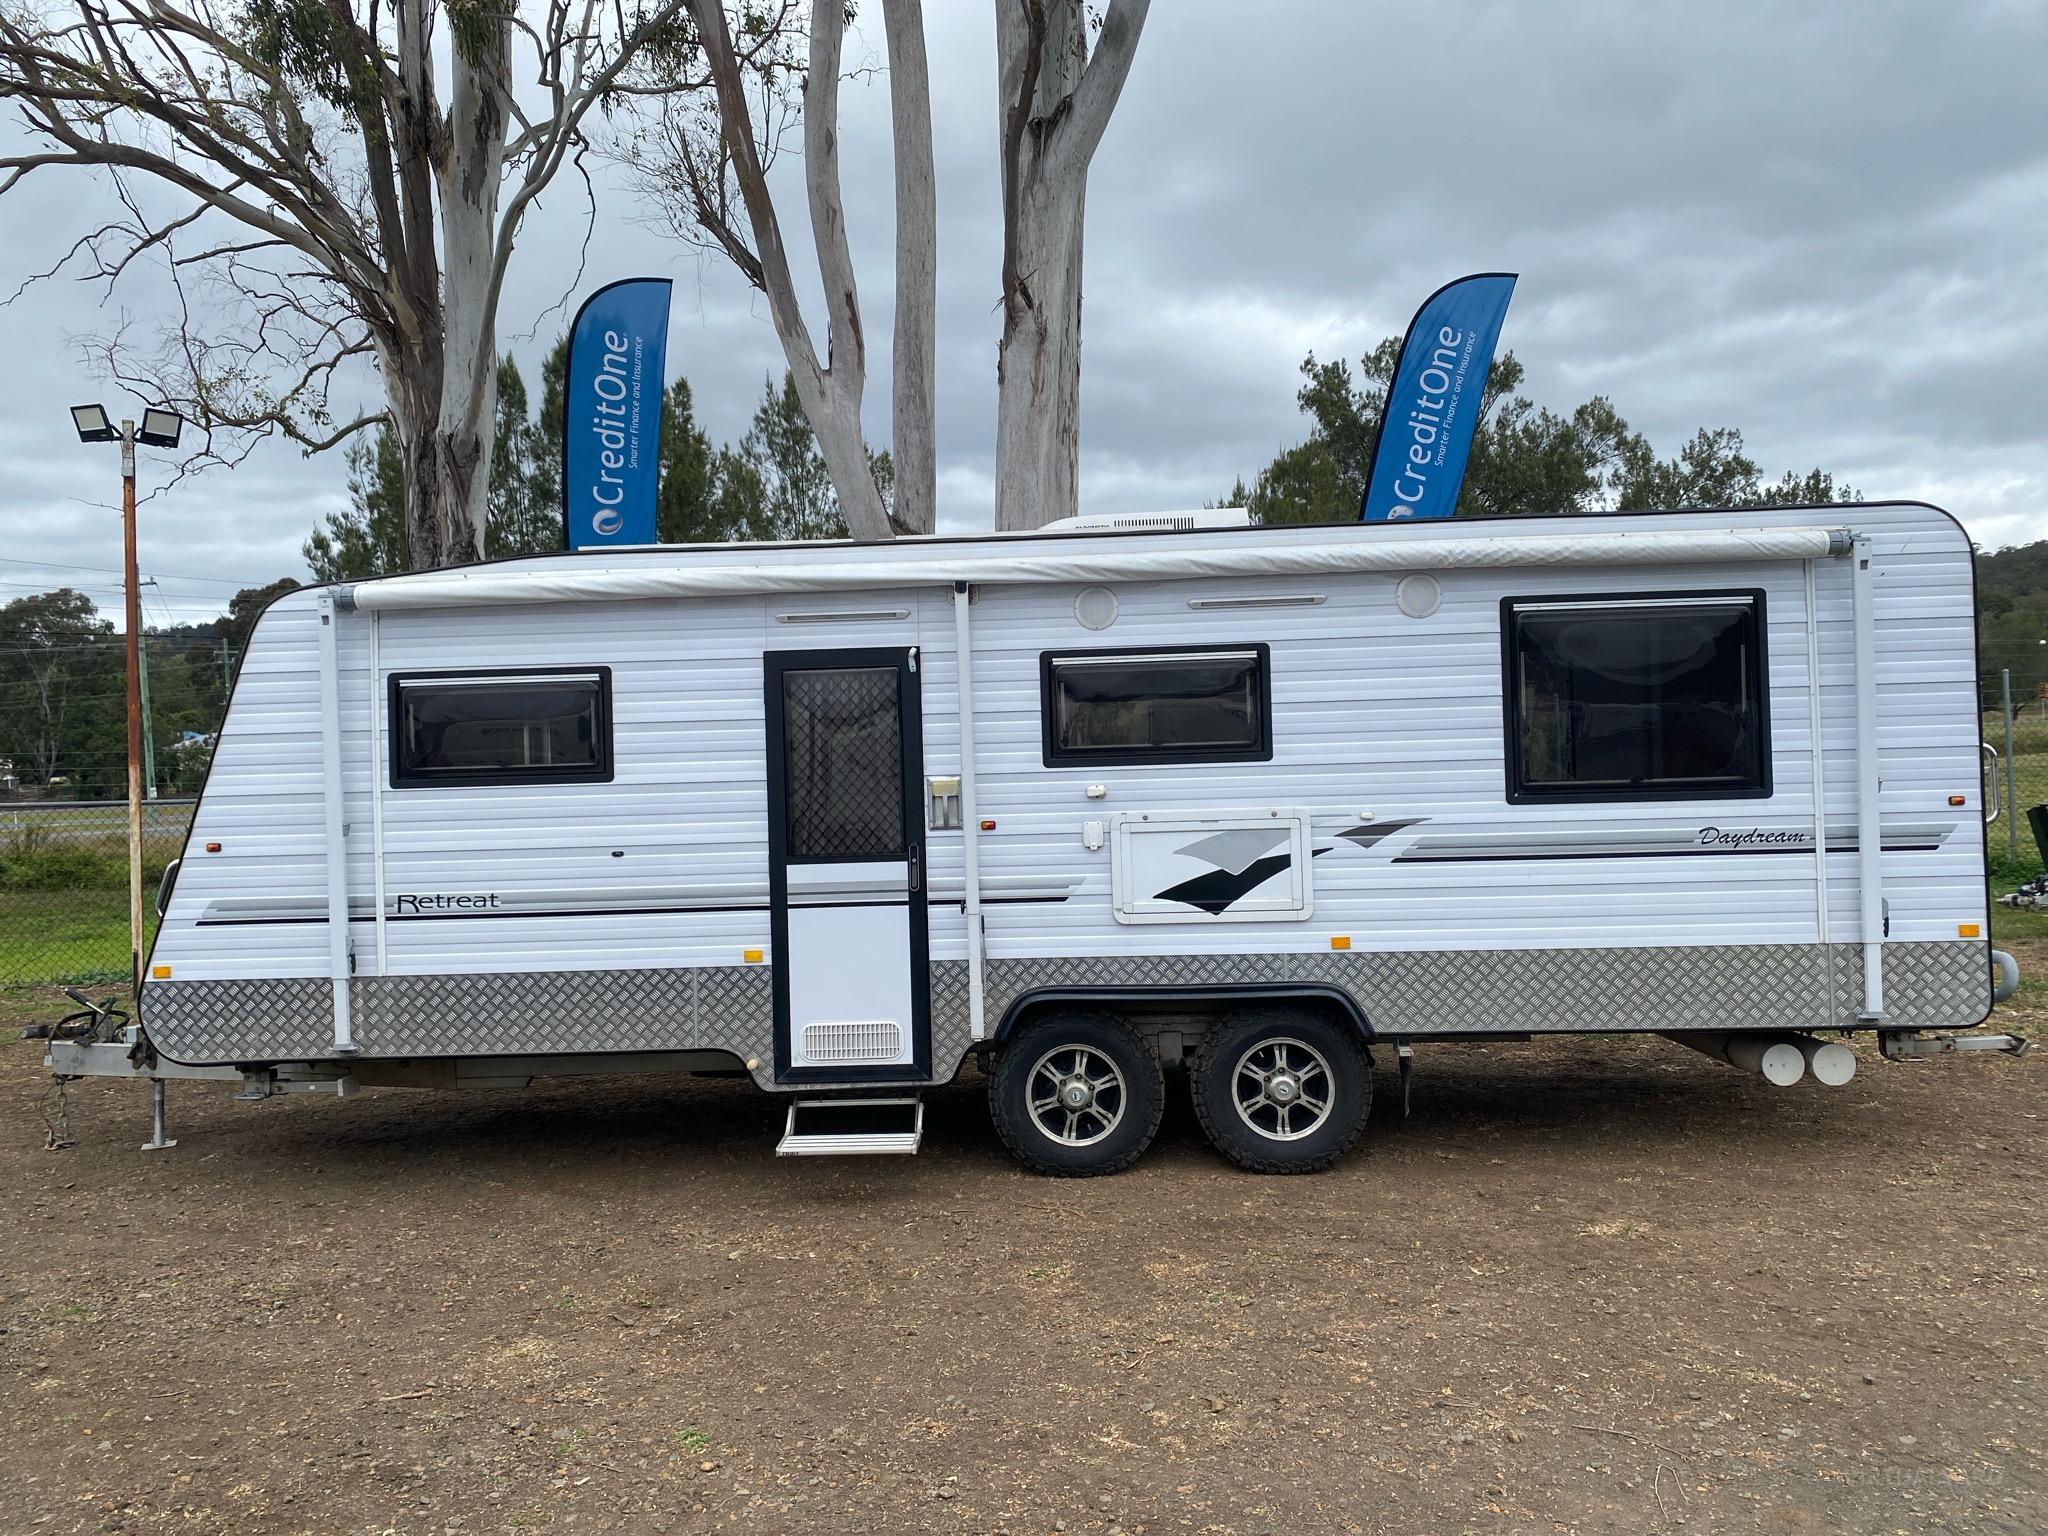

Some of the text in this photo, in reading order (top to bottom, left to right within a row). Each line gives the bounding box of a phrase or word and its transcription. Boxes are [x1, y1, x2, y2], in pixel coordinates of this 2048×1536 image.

[593, 330, 628, 505] CreditOne
[629, 336, 643, 468] Smarter Finance and Insurance
[1394, 326, 1461, 502] CreditOne
[1434, 331, 1476, 467] Smarter Finance and Insurance
[397, 892, 500, 914] Retreat
[1698, 826, 1806, 849] Daydream
